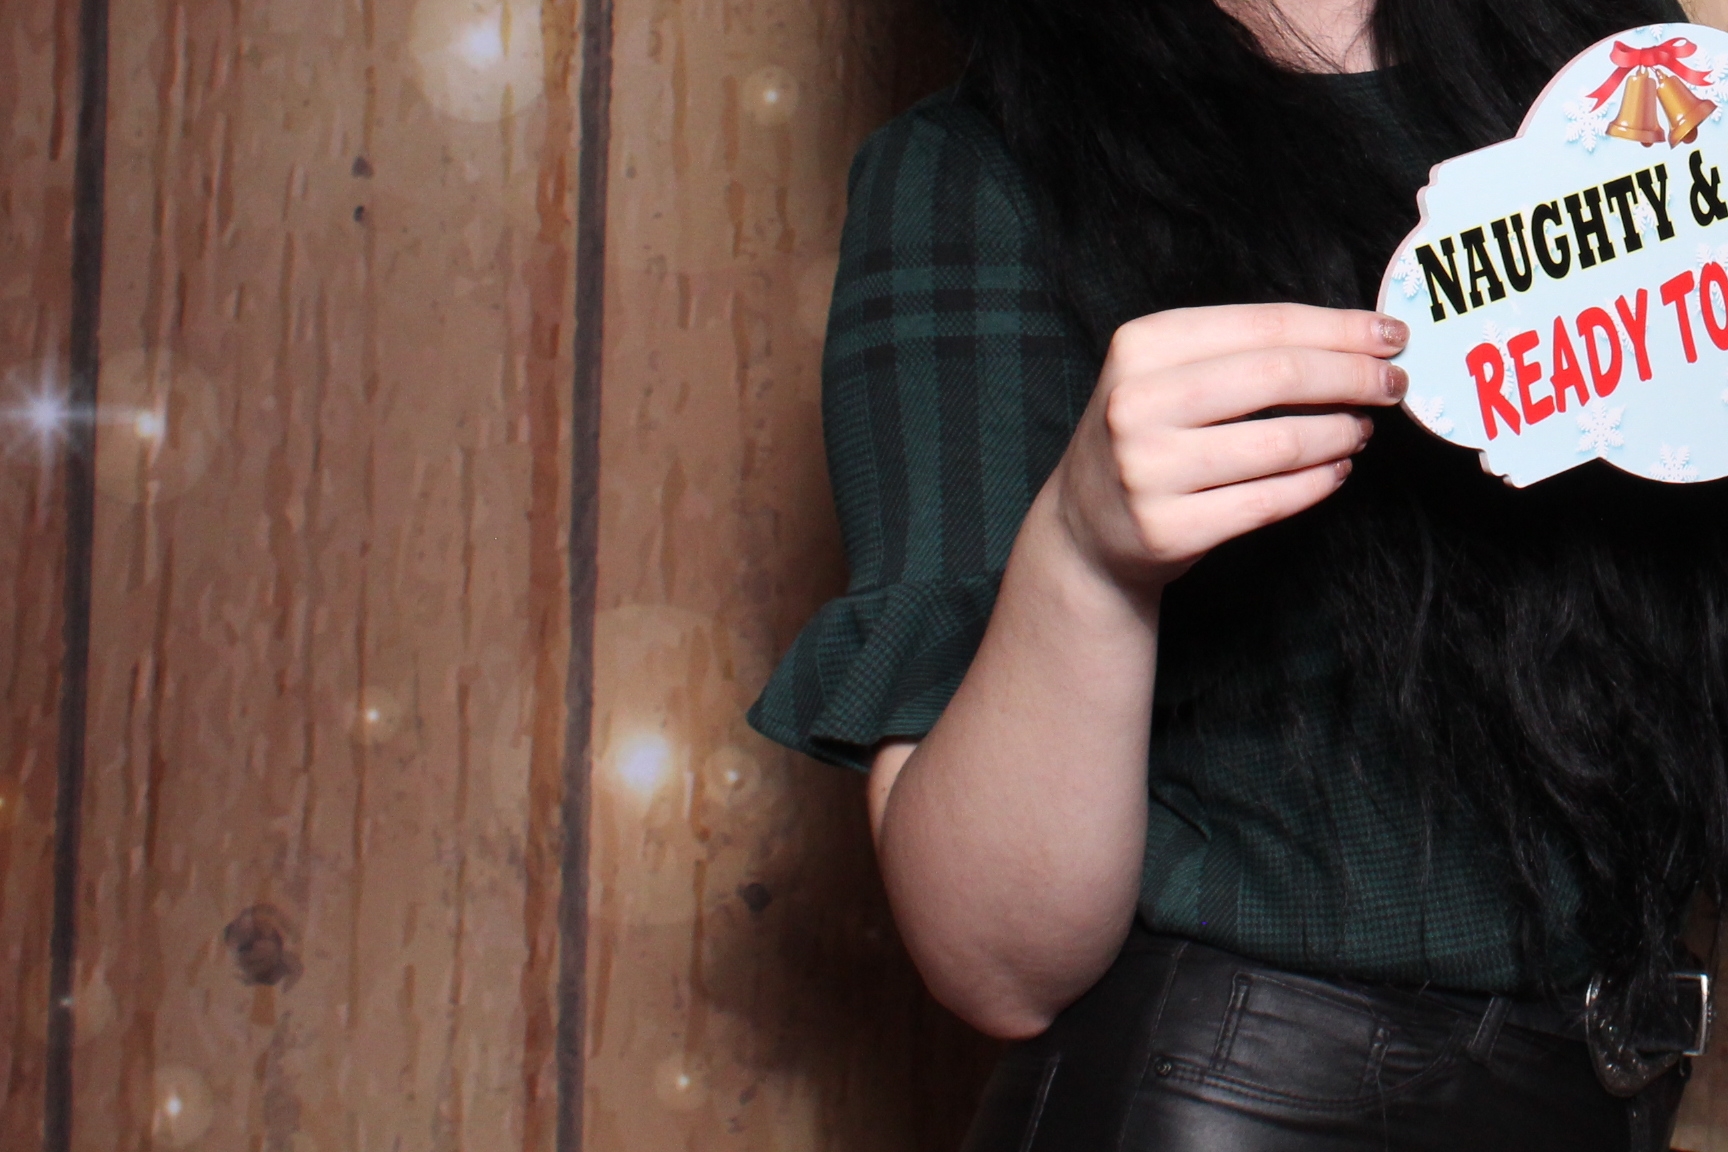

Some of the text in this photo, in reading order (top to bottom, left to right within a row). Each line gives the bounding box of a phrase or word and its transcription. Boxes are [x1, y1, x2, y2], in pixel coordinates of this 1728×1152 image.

[1415, 163, 1675, 322] NAUGHTY
[1689, 149, 1728, 227] &
[1465, 288, 1653, 440] READY
